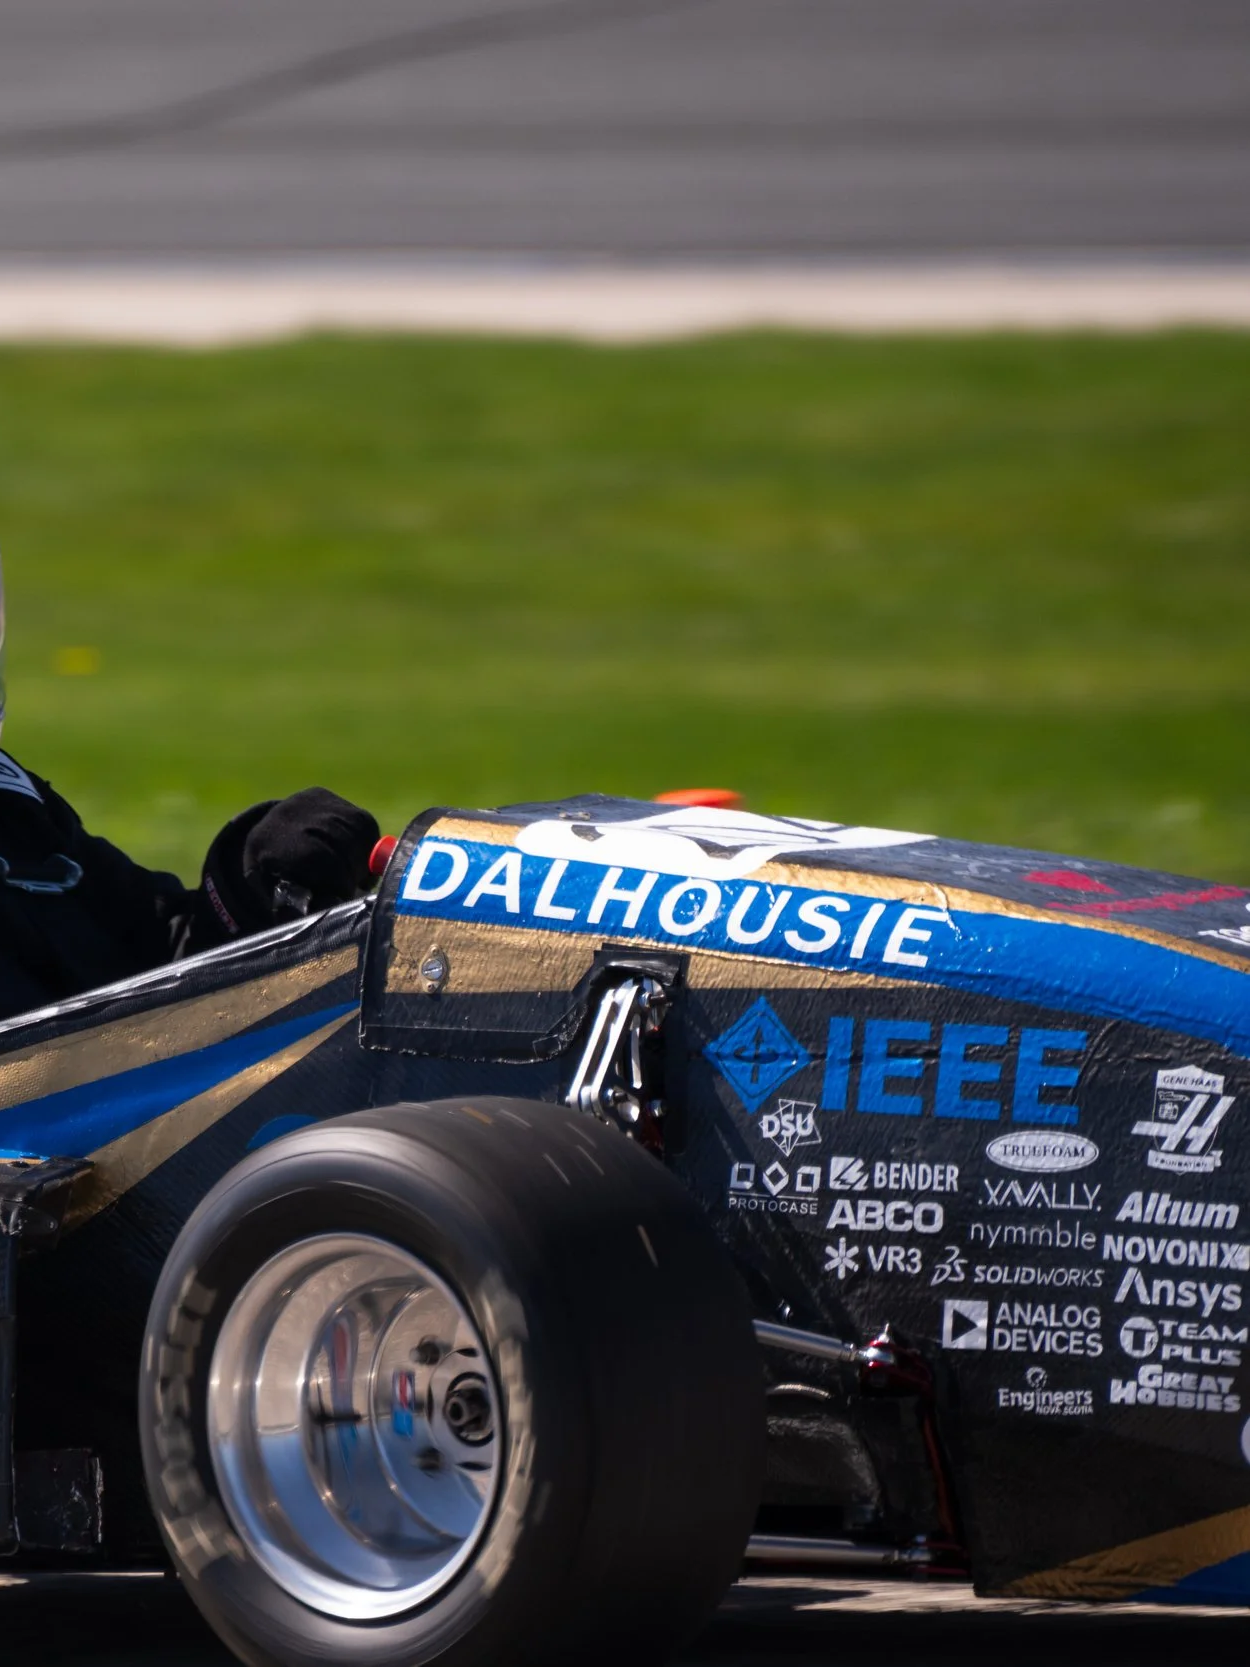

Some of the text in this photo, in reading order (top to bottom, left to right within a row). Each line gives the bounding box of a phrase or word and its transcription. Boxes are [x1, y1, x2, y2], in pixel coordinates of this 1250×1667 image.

[401, 840, 950, 969] DALHOUSIE
[820, 1016, 1088, 1125] IEEE
[1163, 1075, 1217, 1088] GENE HAAS
[762, 1113, 814, 1138] DSU
[1000, 1143, 1085, 1158] TRUEFOAM
[873, 1161, 959, 1192] BENDER
[728, 1197, 818, 1215] PROTOCASE
[826, 1199, 944, 1234] ABCO
[1115, 1191, 1240, 1229] Altium
[970, 1220, 1097, 1250] nymmble
[867, 1245, 922, 1275] VR3
[1102, 1234, 1240, 1269] NOVONIX
[973, 1264, 1105, 1288] SOLIDWORKS
[1113, 1267, 1242, 1318] Ansys
[995, 1302, 1102, 1329] ANALOG
[992, 1328, 1103, 1357] DEVICES
[1158, 1319, 1249, 1344] TEAM
[1161, 1343, 1242, 1367] PLUS
[1138, 1363, 1235, 1394] GREAT
[997, 1387, 1093, 1411] Engineers
[1035, 1404, 1094, 1416] NOVA SCOTIA
[1110, 1378, 1241, 1413] HOBBIES
